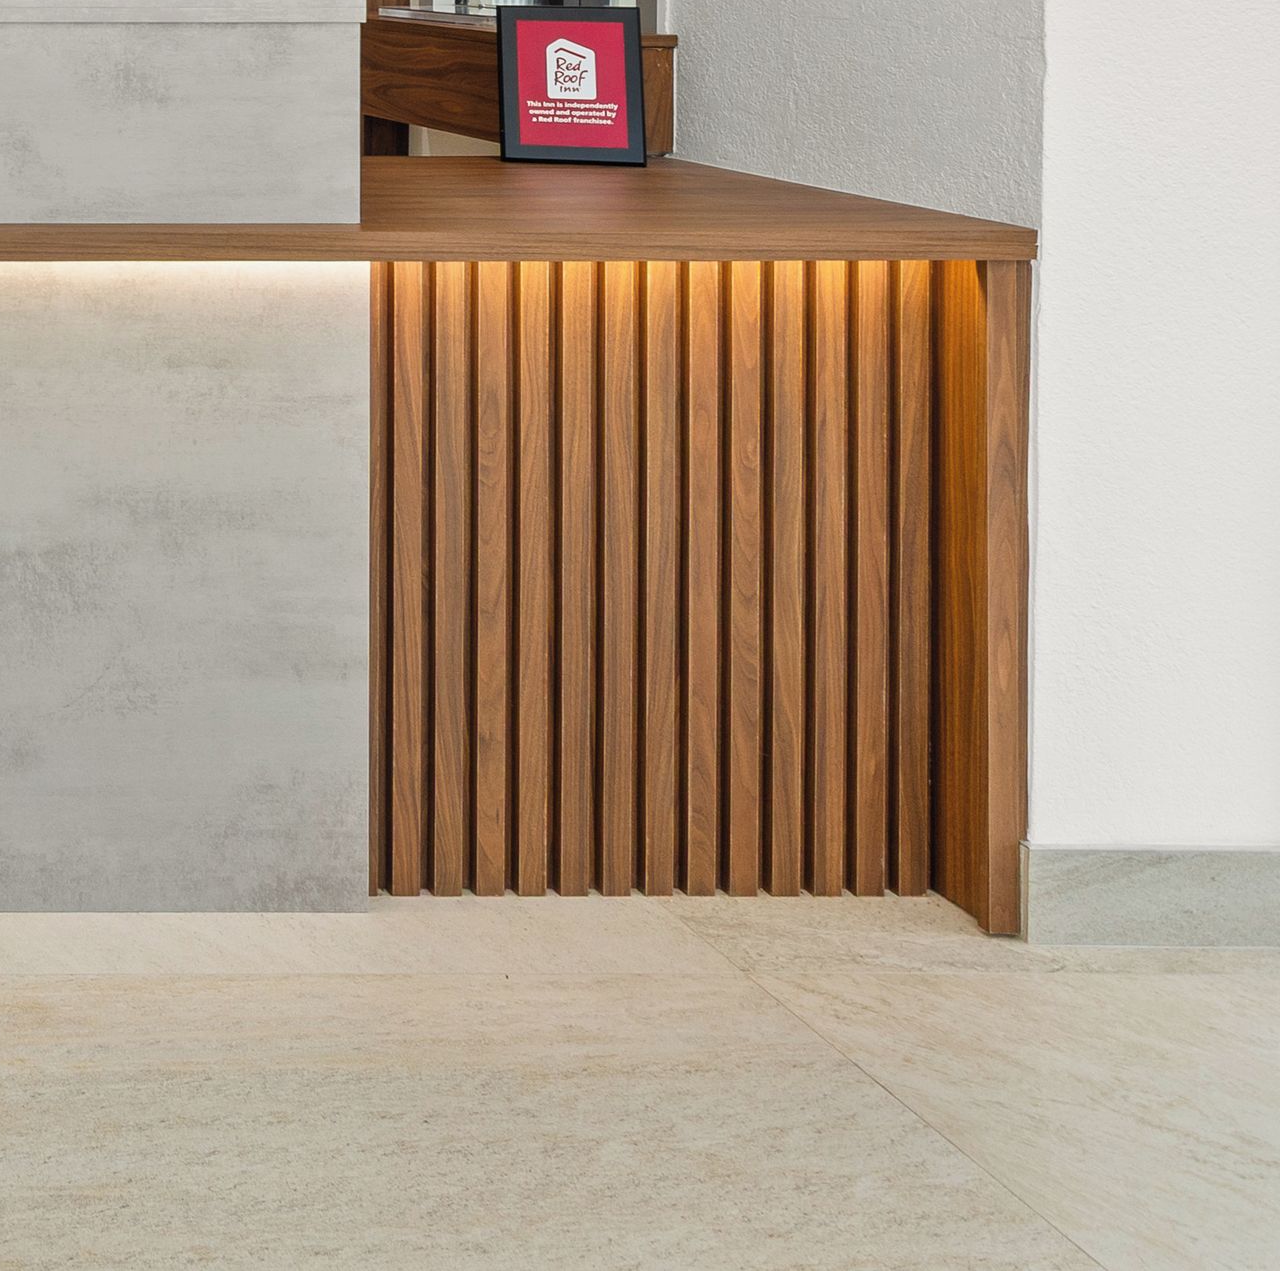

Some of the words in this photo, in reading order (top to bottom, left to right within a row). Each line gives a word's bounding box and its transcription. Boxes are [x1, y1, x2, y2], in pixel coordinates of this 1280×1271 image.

[556, 57, 581, 71] Red
[554, 70, 588, 86] Roof
[564, 102, 618, 110] independently
[606, 110, 616, 118] by
[572, 117, 614, 125] franchisee.
